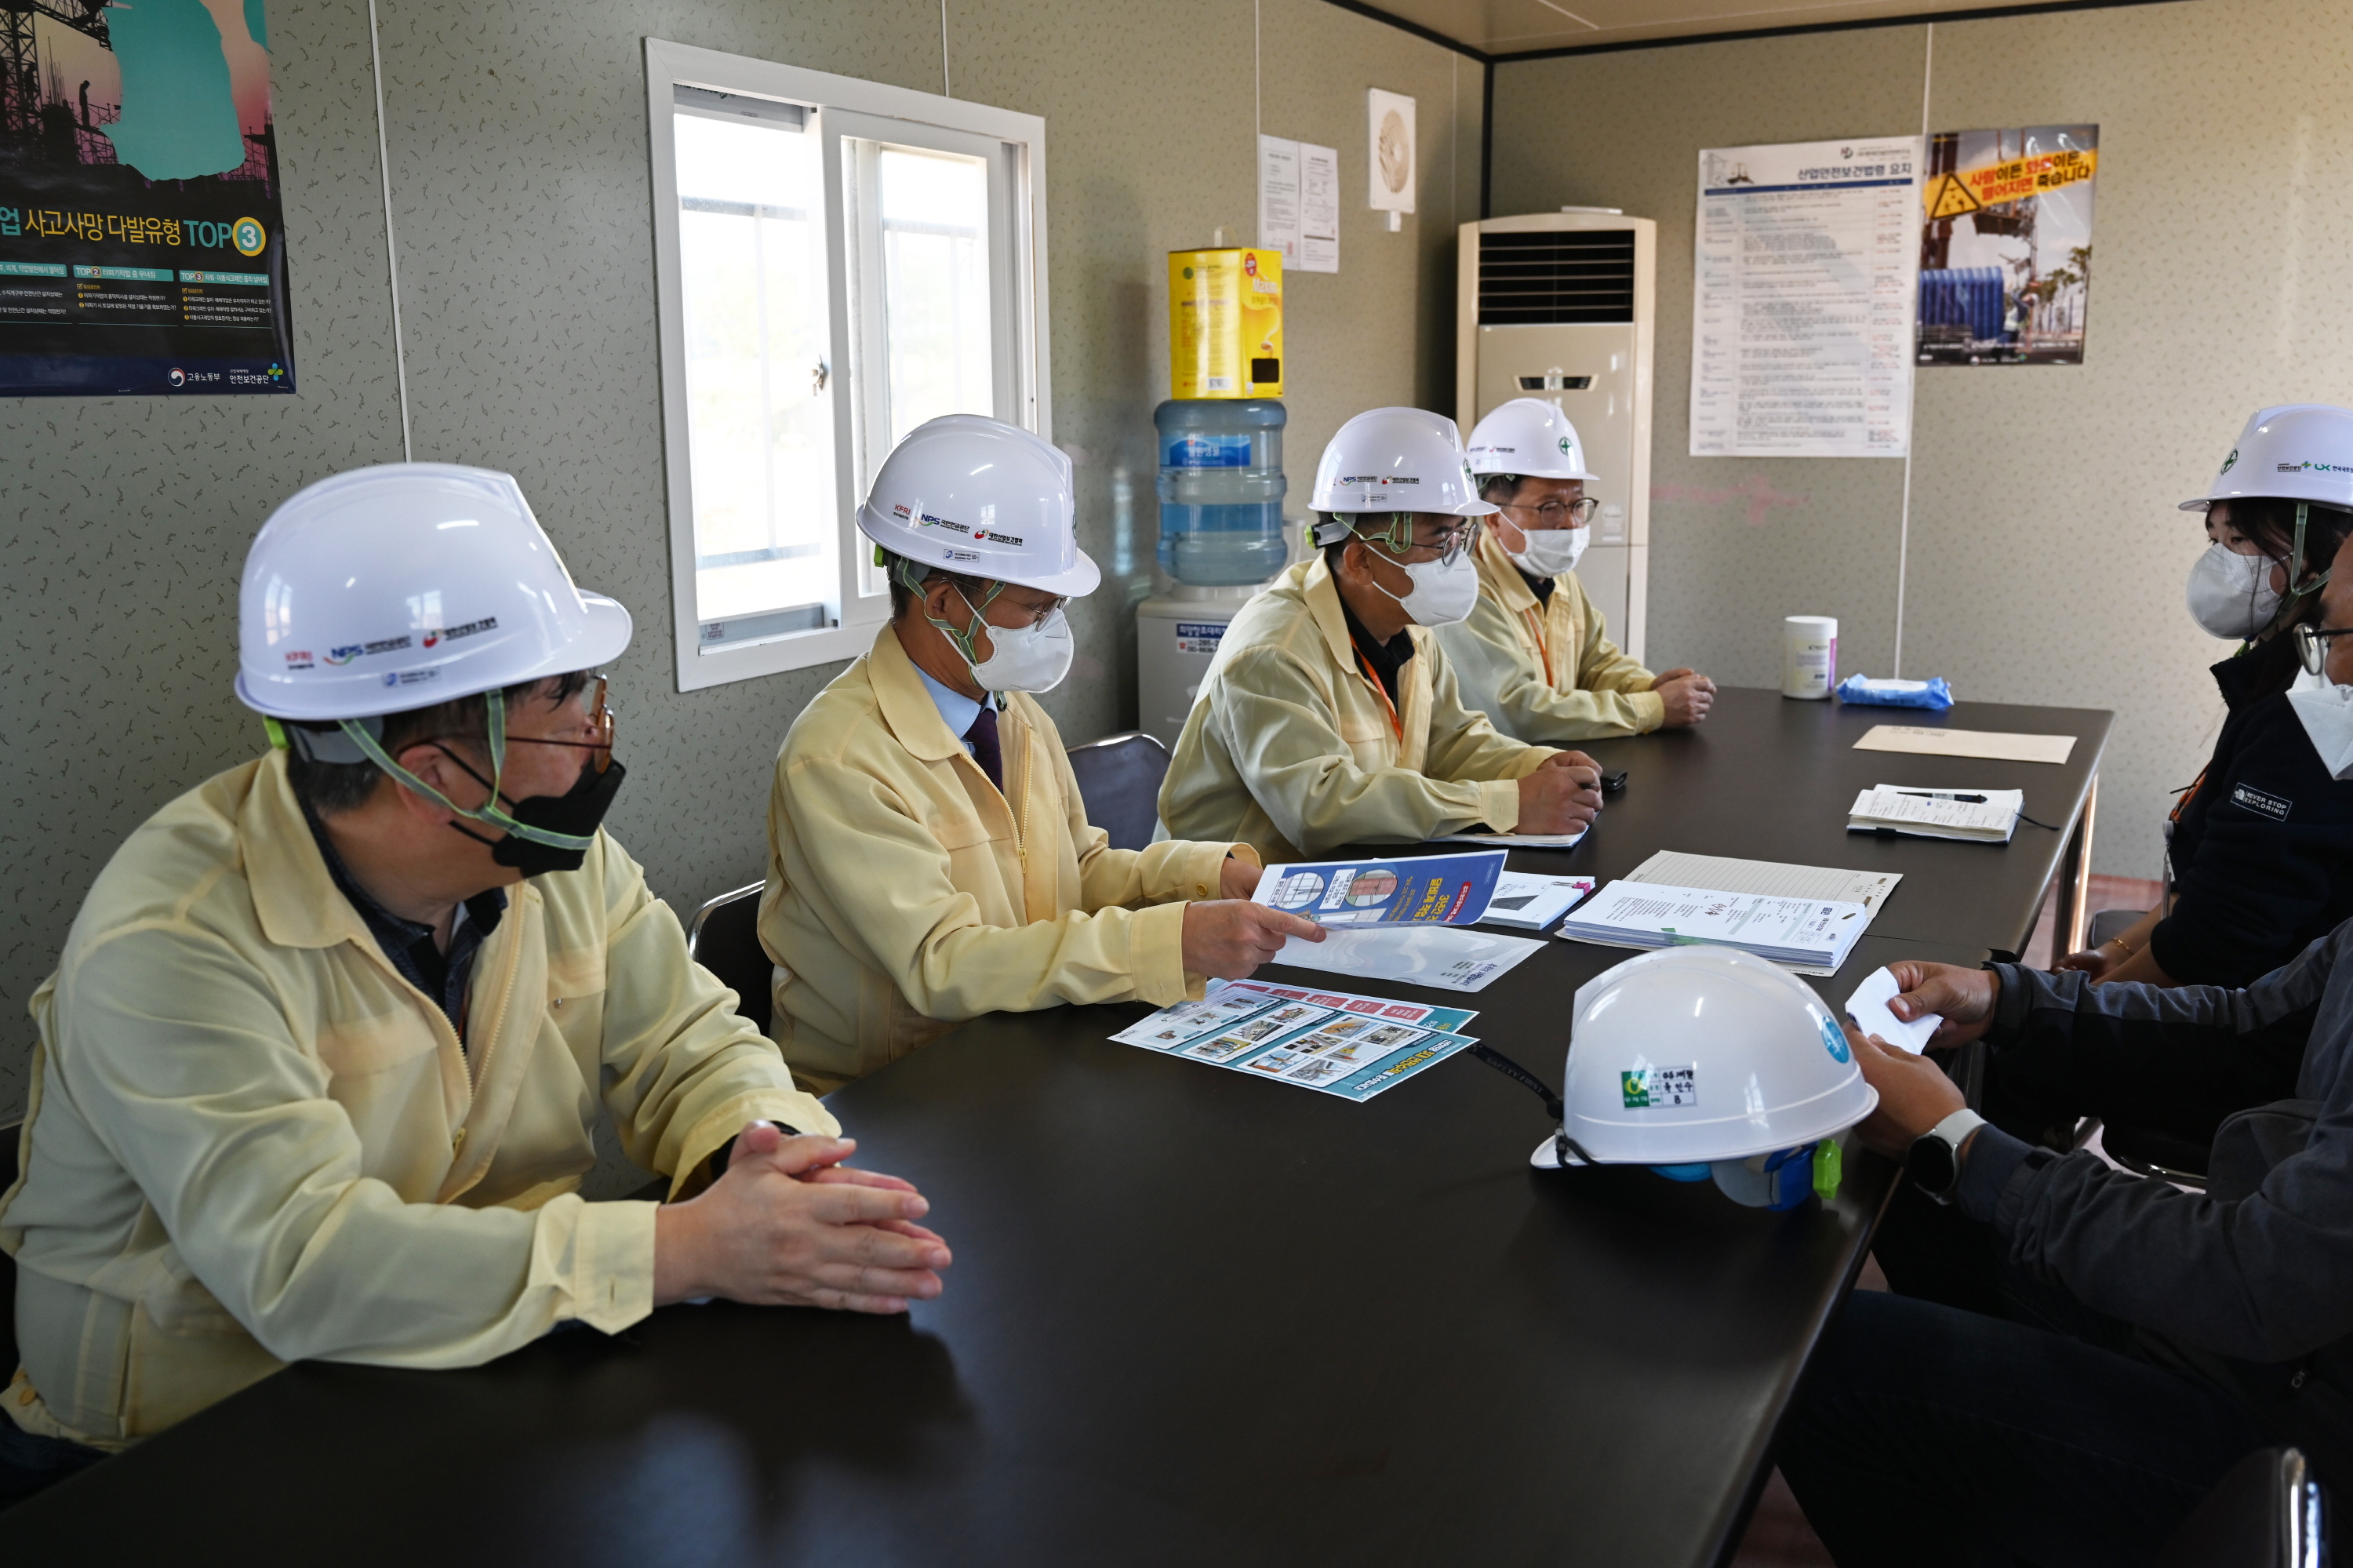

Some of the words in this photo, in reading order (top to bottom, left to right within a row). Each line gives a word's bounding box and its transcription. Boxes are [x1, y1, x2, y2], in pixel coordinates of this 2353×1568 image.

[1798, 165, 1886, 180] 산업안전보건법령
[1889, 162, 1912, 175] 요지
[1970, 163, 2022, 187] 사람이든
[1982, 176, 2034, 202] 떨어지면
[2038, 165, 2091, 187] 죽습니다
[25, 209, 104, 241] 사고사망
[107, 215, 182, 246] 다발유형
[184, 220, 233, 248] TOP
[242, 225, 257, 248] 3
[49, 266, 64, 275] 떨어짐
[76, 267, 91, 276] TOP
[103, 268, 131, 278] 터파기작업
[1252, 278, 1278, 294] Maxim
[187, 373, 220, 382] 고용노동부
[229, 375, 269, 384] 안전보건공단
[895, 504, 911, 515] KFRI
[921, 514, 940, 526] NPS
[941, 519, 970, 530] 국민연금공단
[2244, 797, 2286, 816] EXPLORING
[2246, 791, 2268, 803] NEVER
[2268, 799, 2287, 809] STOP
[1423, 878, 1443, 904] 달비계
[1414, 904, 1431, 918] 작업
[1431, 894, 1449, 915] 3년간
[1486, 1057, 1520, 1077] SAFETY
[1519, 1075, 1544, 1093] FIRST
[1674, 1095, 1681, 1104] B
